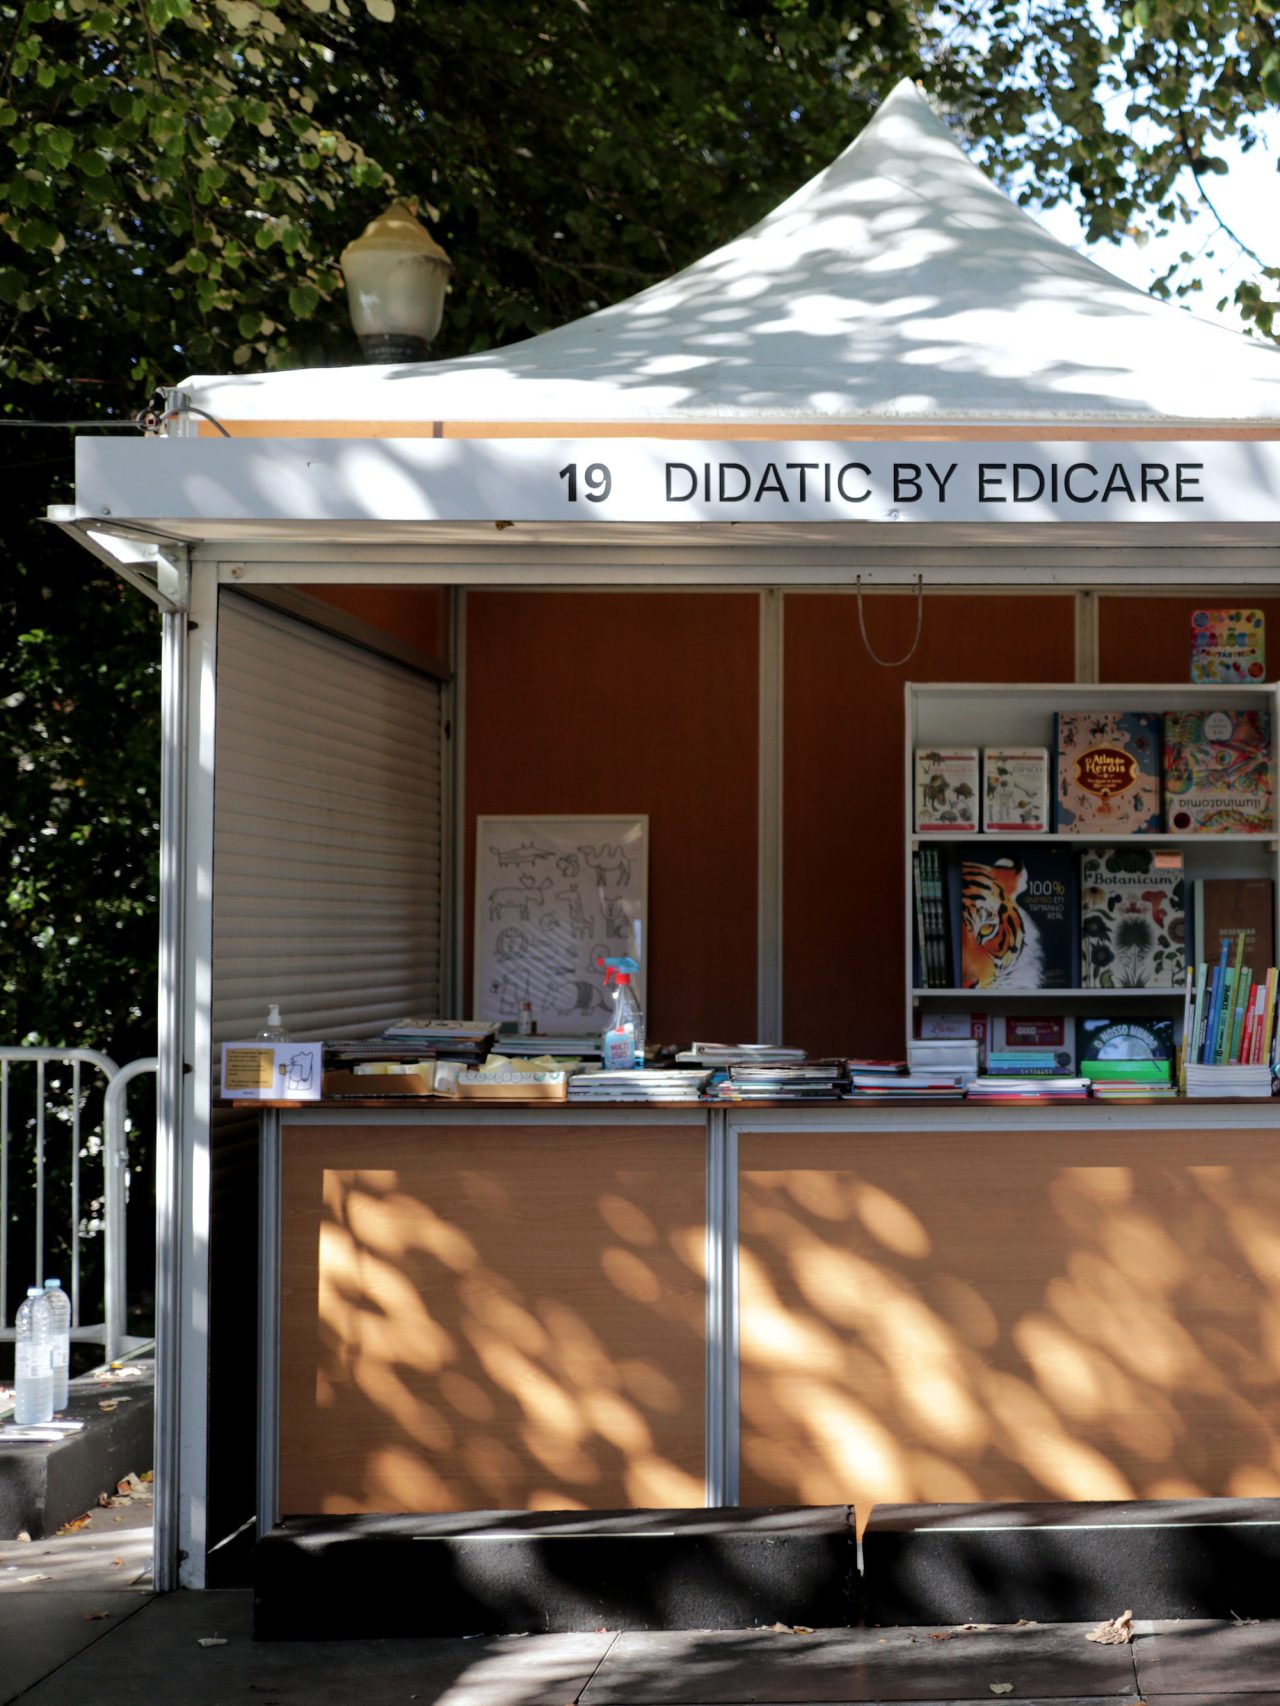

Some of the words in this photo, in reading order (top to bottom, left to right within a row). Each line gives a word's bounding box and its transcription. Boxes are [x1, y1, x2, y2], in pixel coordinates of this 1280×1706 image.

[558, 463, 613, 502] 19
[665, 463, 873, 504] DIDATIC
[892, 463, 958, 503] BY
[979, 463, 1205, 503] EDICARE
[1093, 754, 1114, 765] Atlas
[1178, 799, 1261, 809] iluminatomia
[1094, 873, 1173, 885] Botanicum
[1028, 880, 1065, 896] 100%
[1099, 1023, 1128, 1042] NOSSO
[1129, 1023, 1159, 1050] MUNDO
[610, 1042, 629, 1052] MULTI
